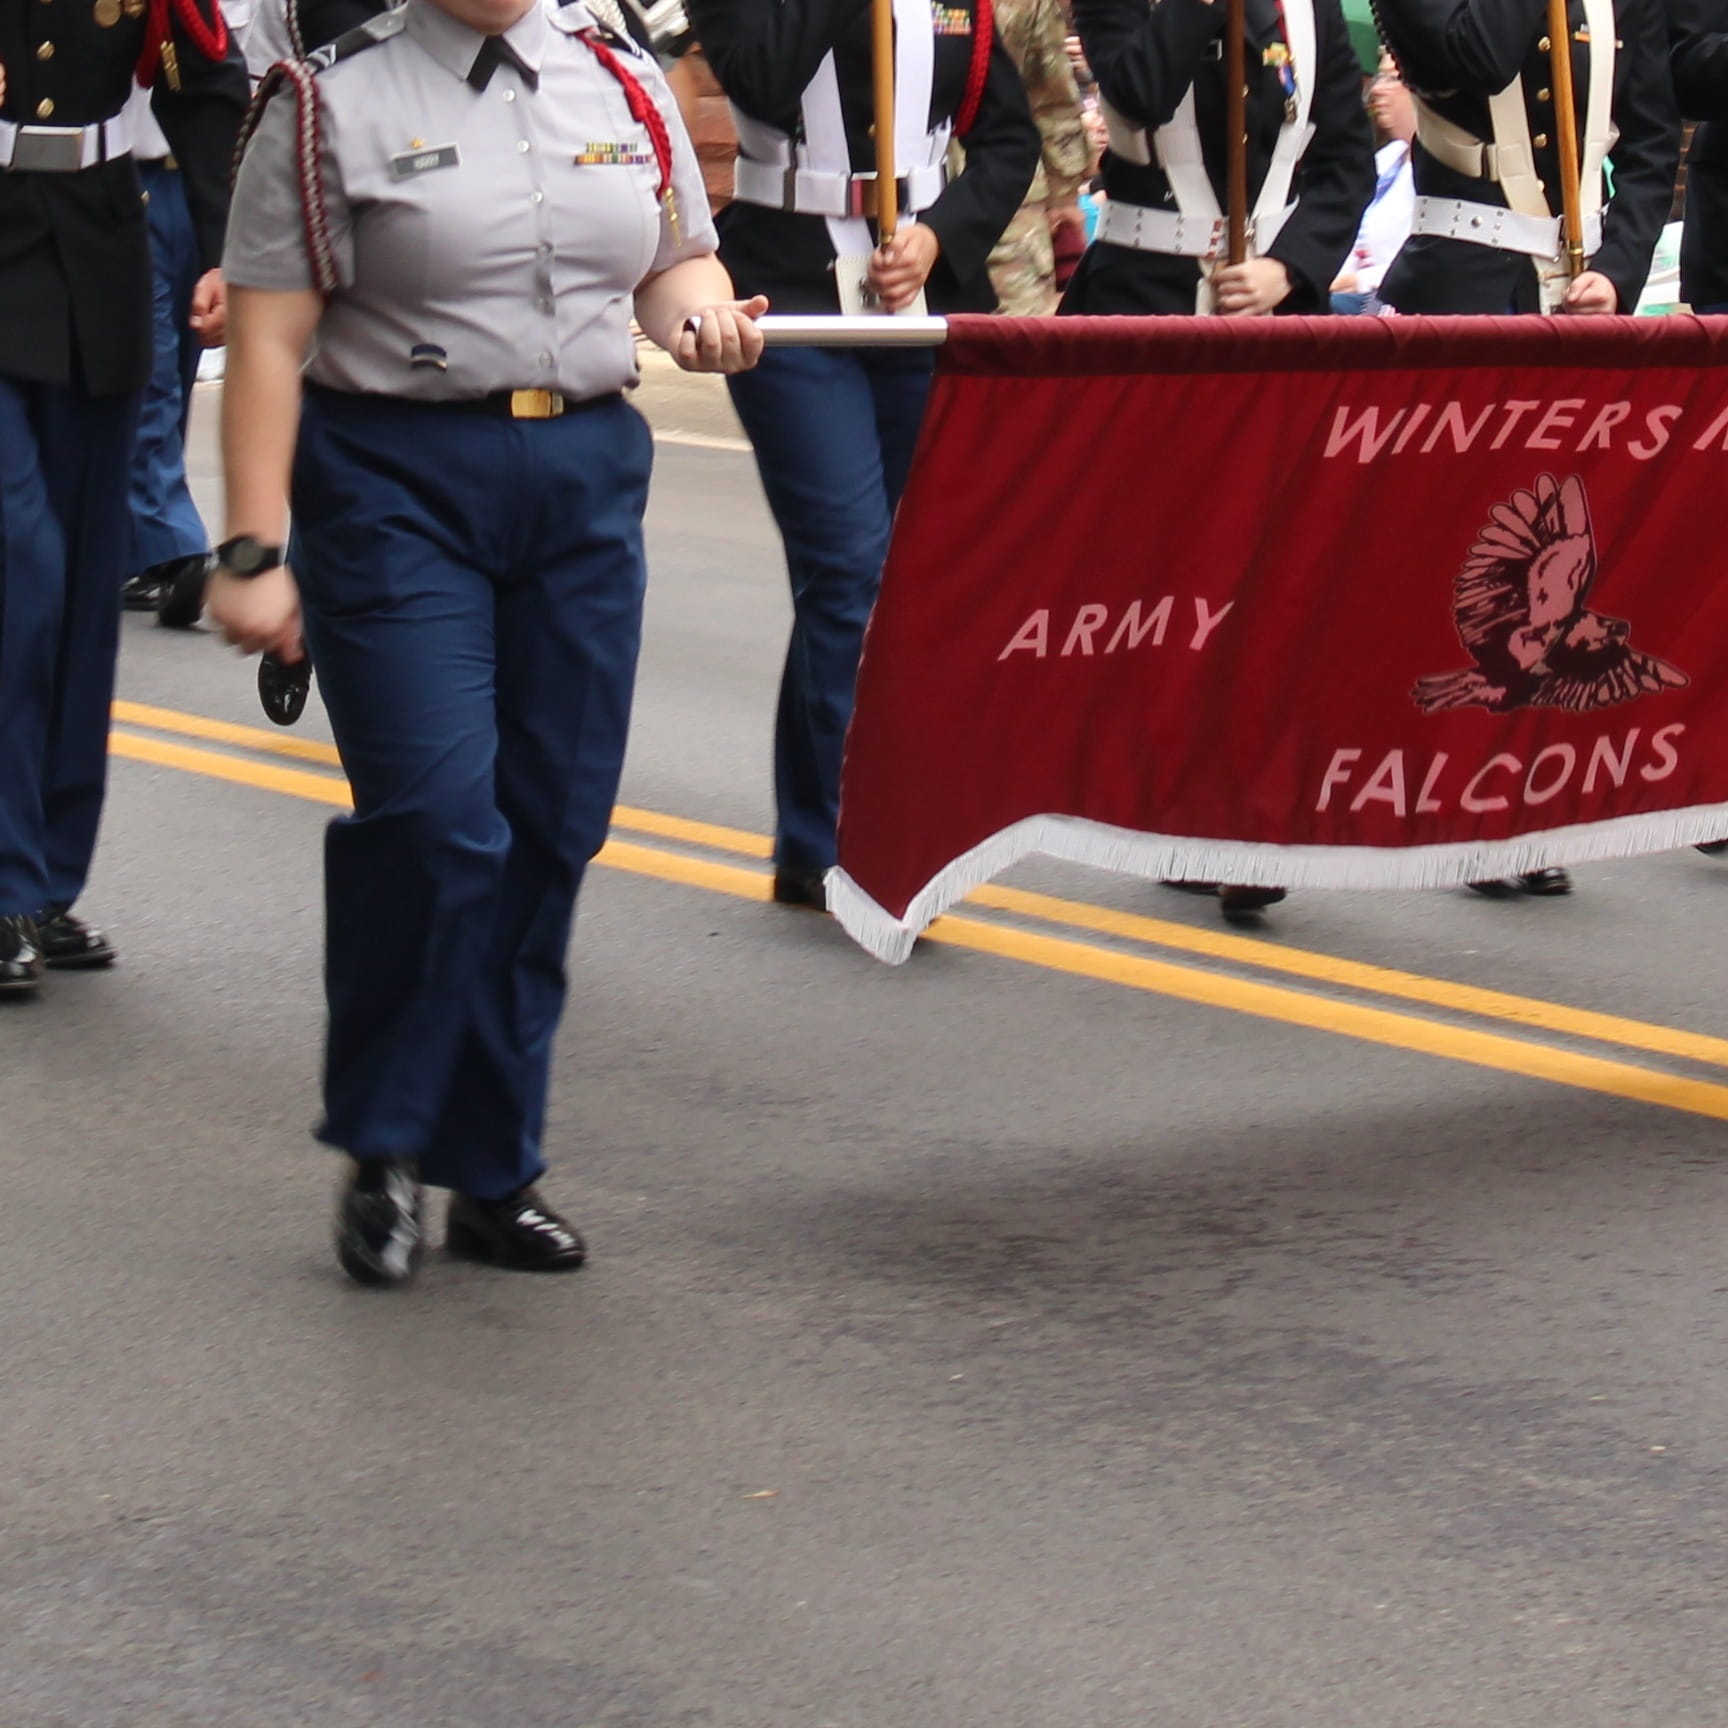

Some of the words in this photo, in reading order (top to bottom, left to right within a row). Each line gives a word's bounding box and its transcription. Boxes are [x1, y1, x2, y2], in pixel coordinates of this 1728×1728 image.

[1324, 398, 1683, 464] WINTERS
[996, 595, 1235, 662] ARMY
[1315, 723, 1686, 818] FALCONS
